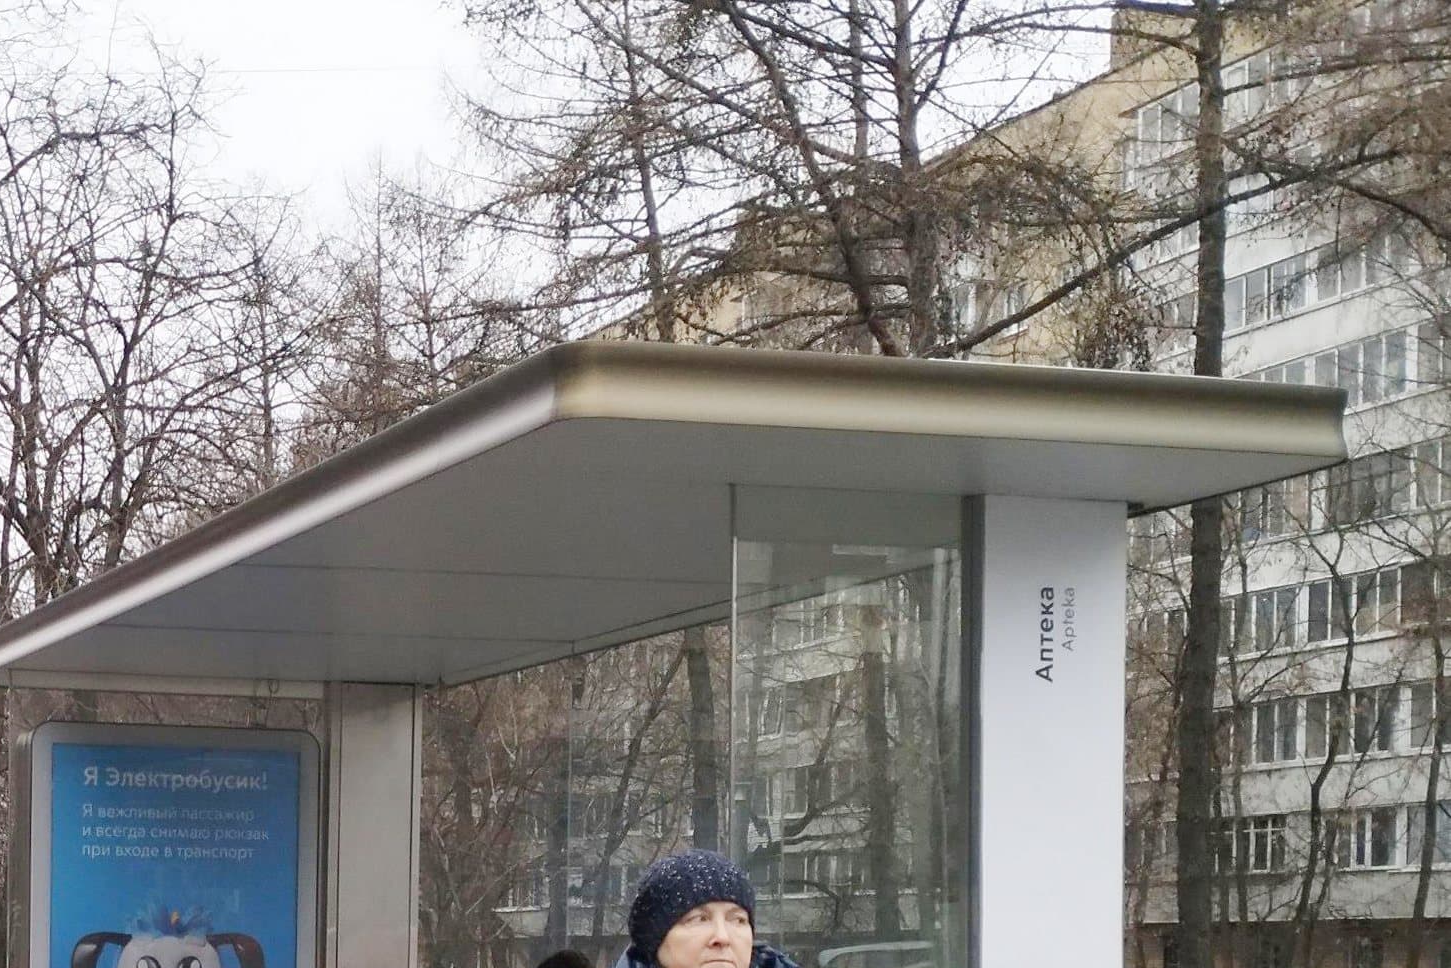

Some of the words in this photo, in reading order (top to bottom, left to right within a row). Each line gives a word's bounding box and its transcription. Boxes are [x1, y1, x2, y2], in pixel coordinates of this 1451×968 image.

[1061, 587, 1077, 651] Apteka
[1035, 586, 1055, 683] Аптека
[84, 766, 98, 786] Я
[105, 767, 268, 793] Электробусик!
[82, 804, 93, 818] Я
[98, 806, 177, 820] вежливый
[181, 808, 255, 823] пассажир
[82, 826, 92, 837] и
[95, 826, 146, 840] всегда
[150, 827, 210, 840] снимаю
[214, 828, 269, 842] рюкзак
[82, 845, 110, 859] при
[115, 846, 159, 858] входе
[164, 847, 173, 858] в
[177, 847, 255, 860] транспорт
